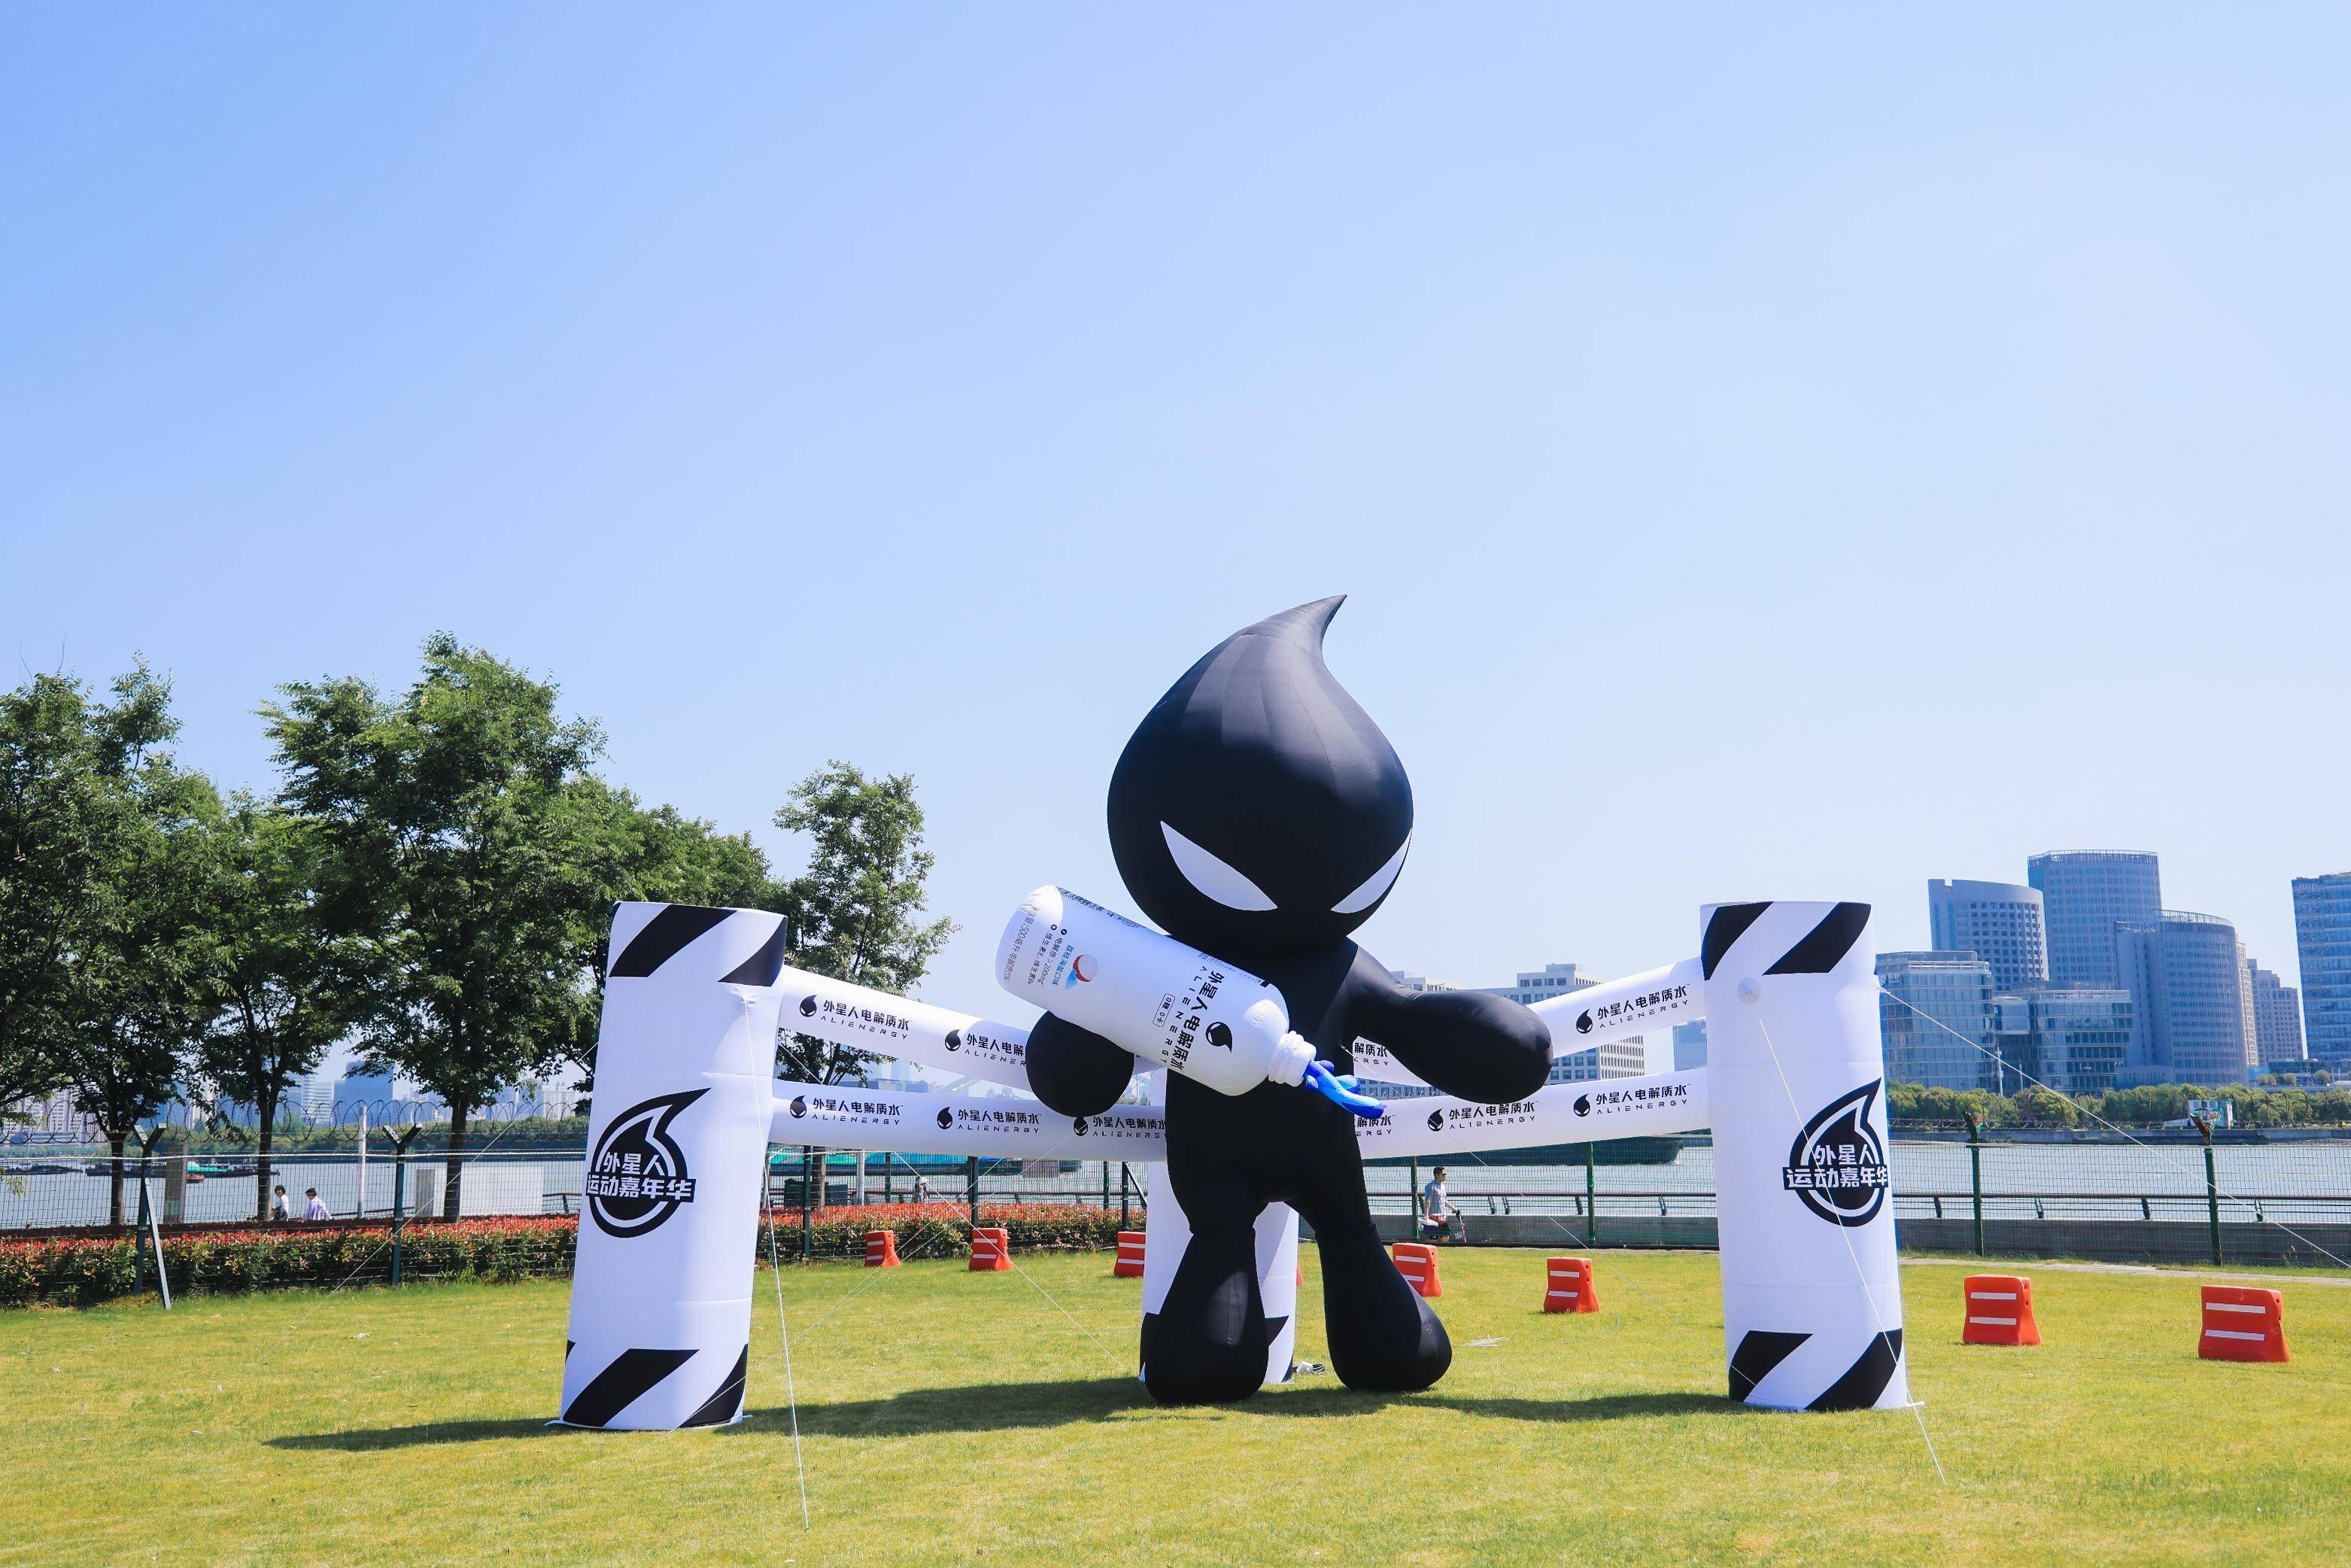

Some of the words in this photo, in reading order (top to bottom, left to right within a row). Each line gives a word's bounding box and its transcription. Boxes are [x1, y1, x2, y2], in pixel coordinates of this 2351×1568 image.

[1597, 985, 1687, 1020] 外星人电解质水
[823, 999, 909, 1031] 外星人电解质水
[1160, 966, 1207, 1063] ALIENERGY
[1171, 971, 1225, 1070] 外星人电解质水
[1599, 1000, 1687, 1029] ALIENERGY
[820, 1015, 908, 1040] ALIENERGY
[966, 1033, 1024, 1056] 外星人电解
[1354, 1042, 1388, 1057] 解质水
[964, 1049, 1026, 1066] ALIENER
[1353, 1057, 1389, 1065] ERGY
[1596, 1084, 1687, 1105] 外星人电解质水
[813, 1098, 901, 1116] 外星人电解质水
[958, 1108, 1039, 1124] 外星人电解质水
[1449, 1102, 1535, 1120] 外星人电解质水
[1596, 1099, 1687, 1114] ALIENERGY
[812, 1114, 900, 1125] ALIENERGY
[958, 1124, 1039, 1134] ALIENERGY
[1354, 1114, 1391, 1128] 解质水
[1449, 1115, 1535, 1129] ALIENERGY
[1356, 1129, 1392, 1137] ERGY
[603, 1152, 665, 1176] 外星人
[1814, 1144, 1873, 1165] 外星人
[1786, 1166, 1888, 1187] 运动嘉年华
[587, 1174, 692, 1200] 运动嘉年华
